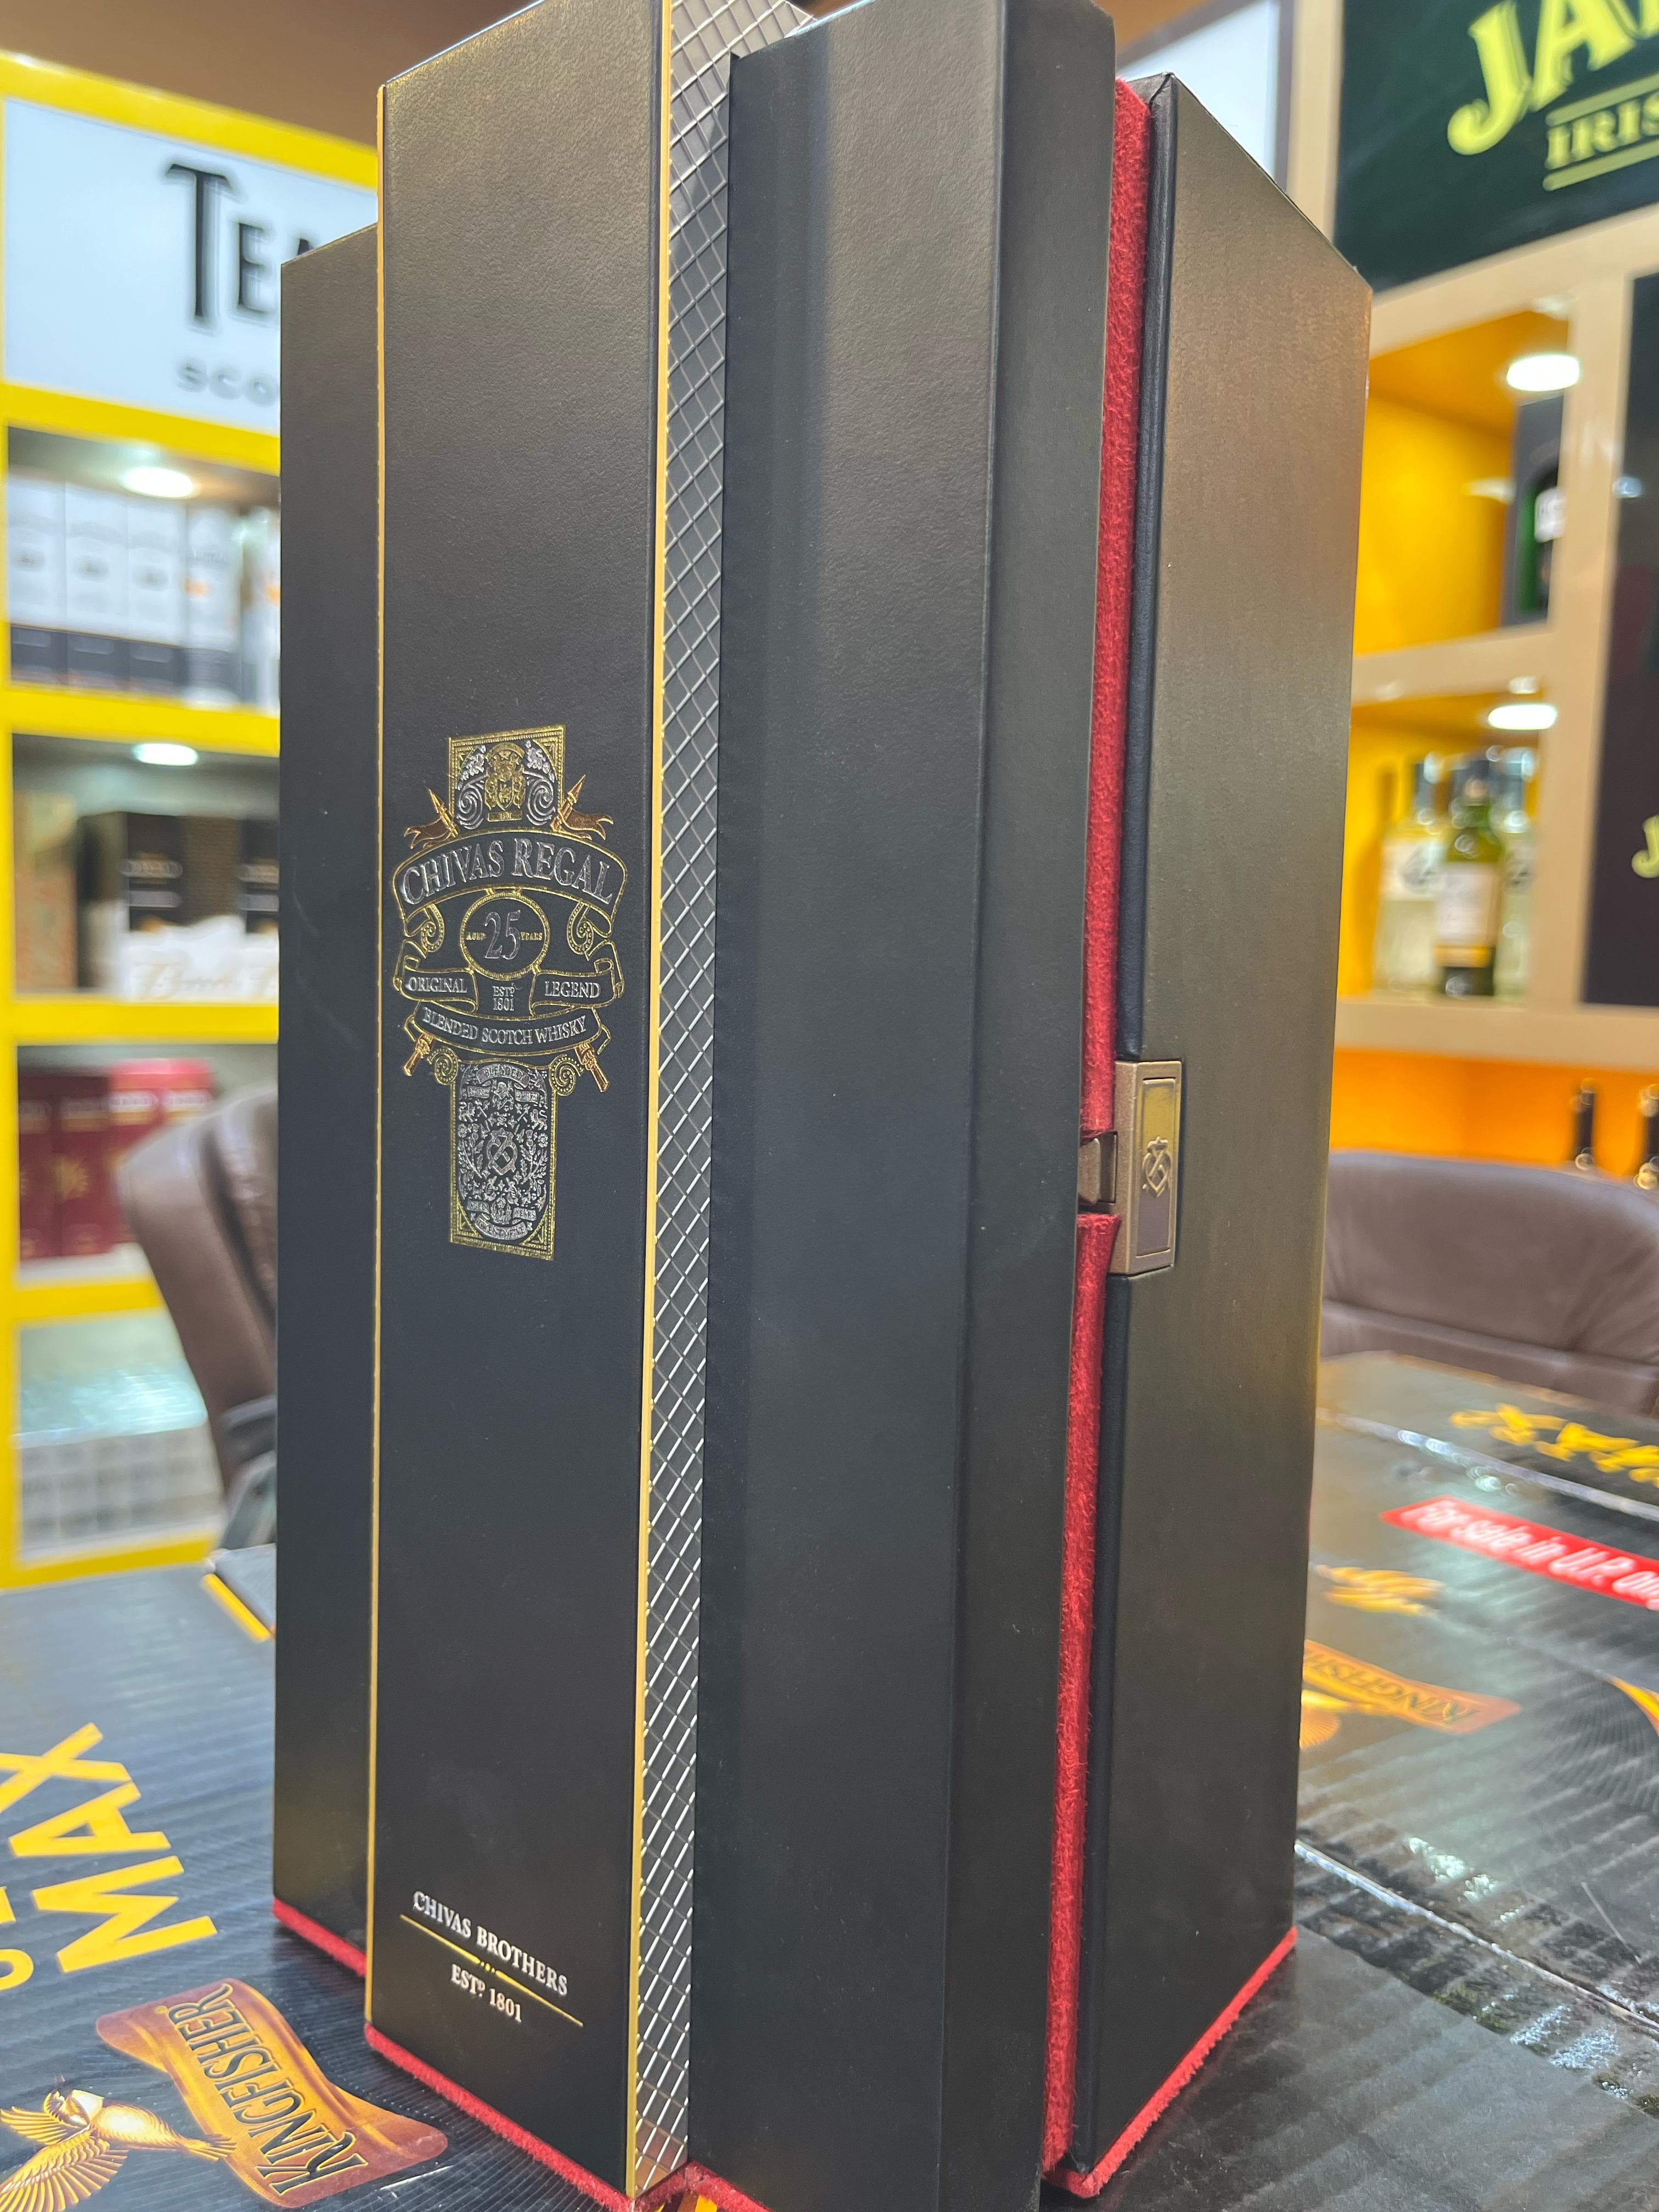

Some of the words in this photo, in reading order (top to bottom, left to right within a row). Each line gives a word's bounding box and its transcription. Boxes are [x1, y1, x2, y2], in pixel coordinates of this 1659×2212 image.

[402, 839, 504, 905] CHIVAS
[511, 838, 613, 905] REGAL
[484, 910, 521, 960] 25
[405, 977, 467, 994] ORIGINAL
[493, 997, 515, 1012] 1801
[544, 980, 601, 998] LEGEND
[422, 1006, 479, 1040] BLENDED
[482, 1027, 533, 1045] SCOTCH
[535, 1015, 586, 1043] WHISKY
[0, 1722, 218, 1973] MAX
[413, 1891, 472, 1938] CHIVAS
[476, 1925, 568, 1996] BROTHERS
[489, 1988, 522, 2023] 1801
[167, 1983, 369, 2196] KINGFISHER
